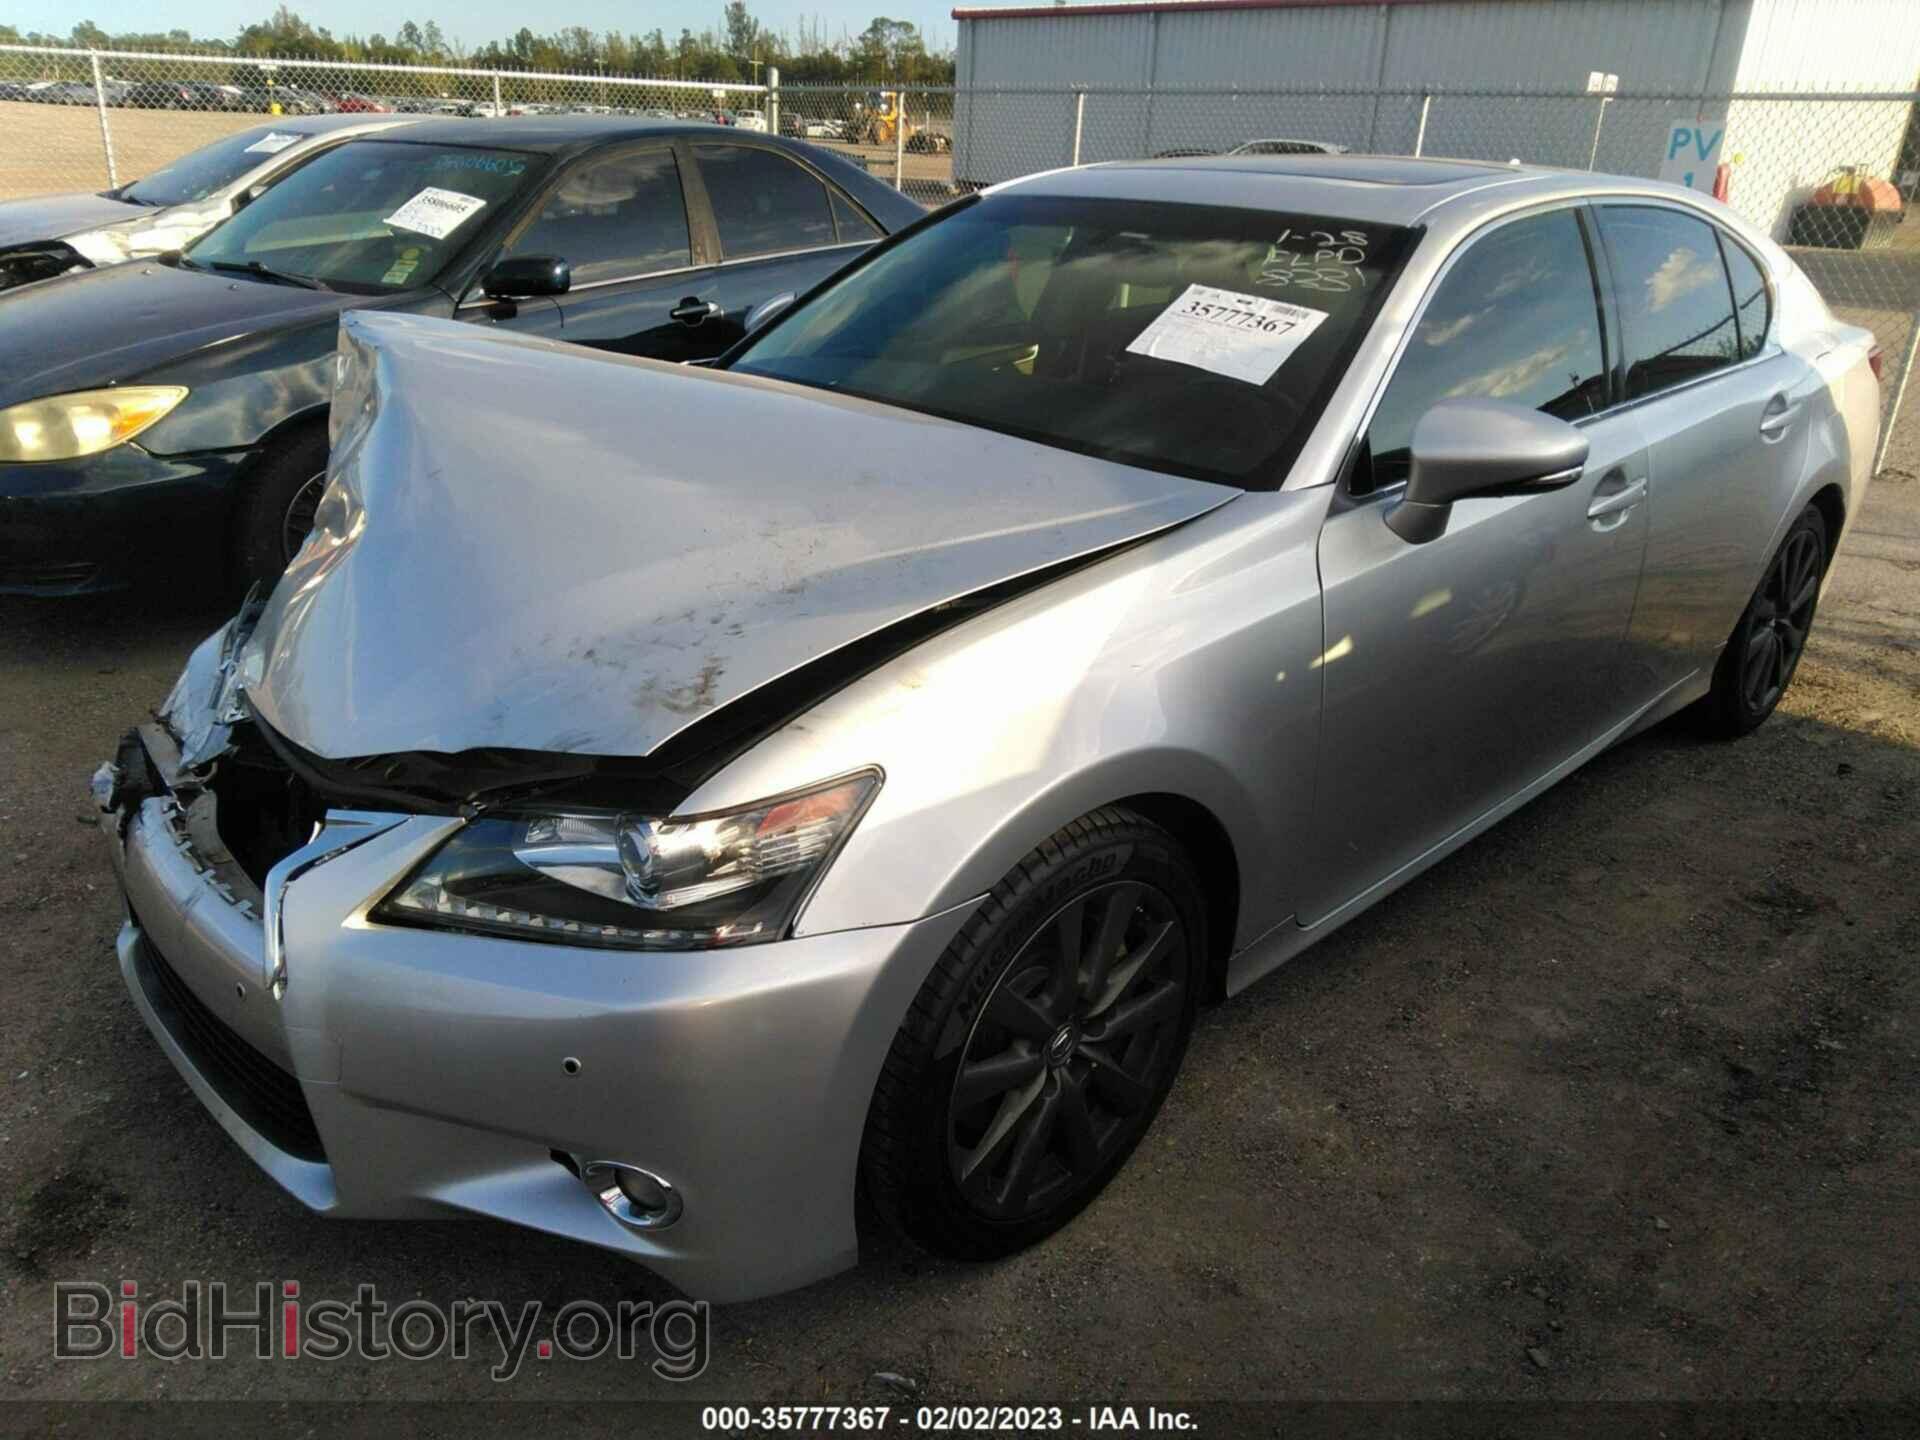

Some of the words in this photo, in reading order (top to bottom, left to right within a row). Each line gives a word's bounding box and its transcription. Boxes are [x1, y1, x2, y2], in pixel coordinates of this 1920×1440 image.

[1668, 128, 1723, 161] PV
[1276, 229, 1369, 246] 1-28
[1181, 301, 1296, 336] 35777367
